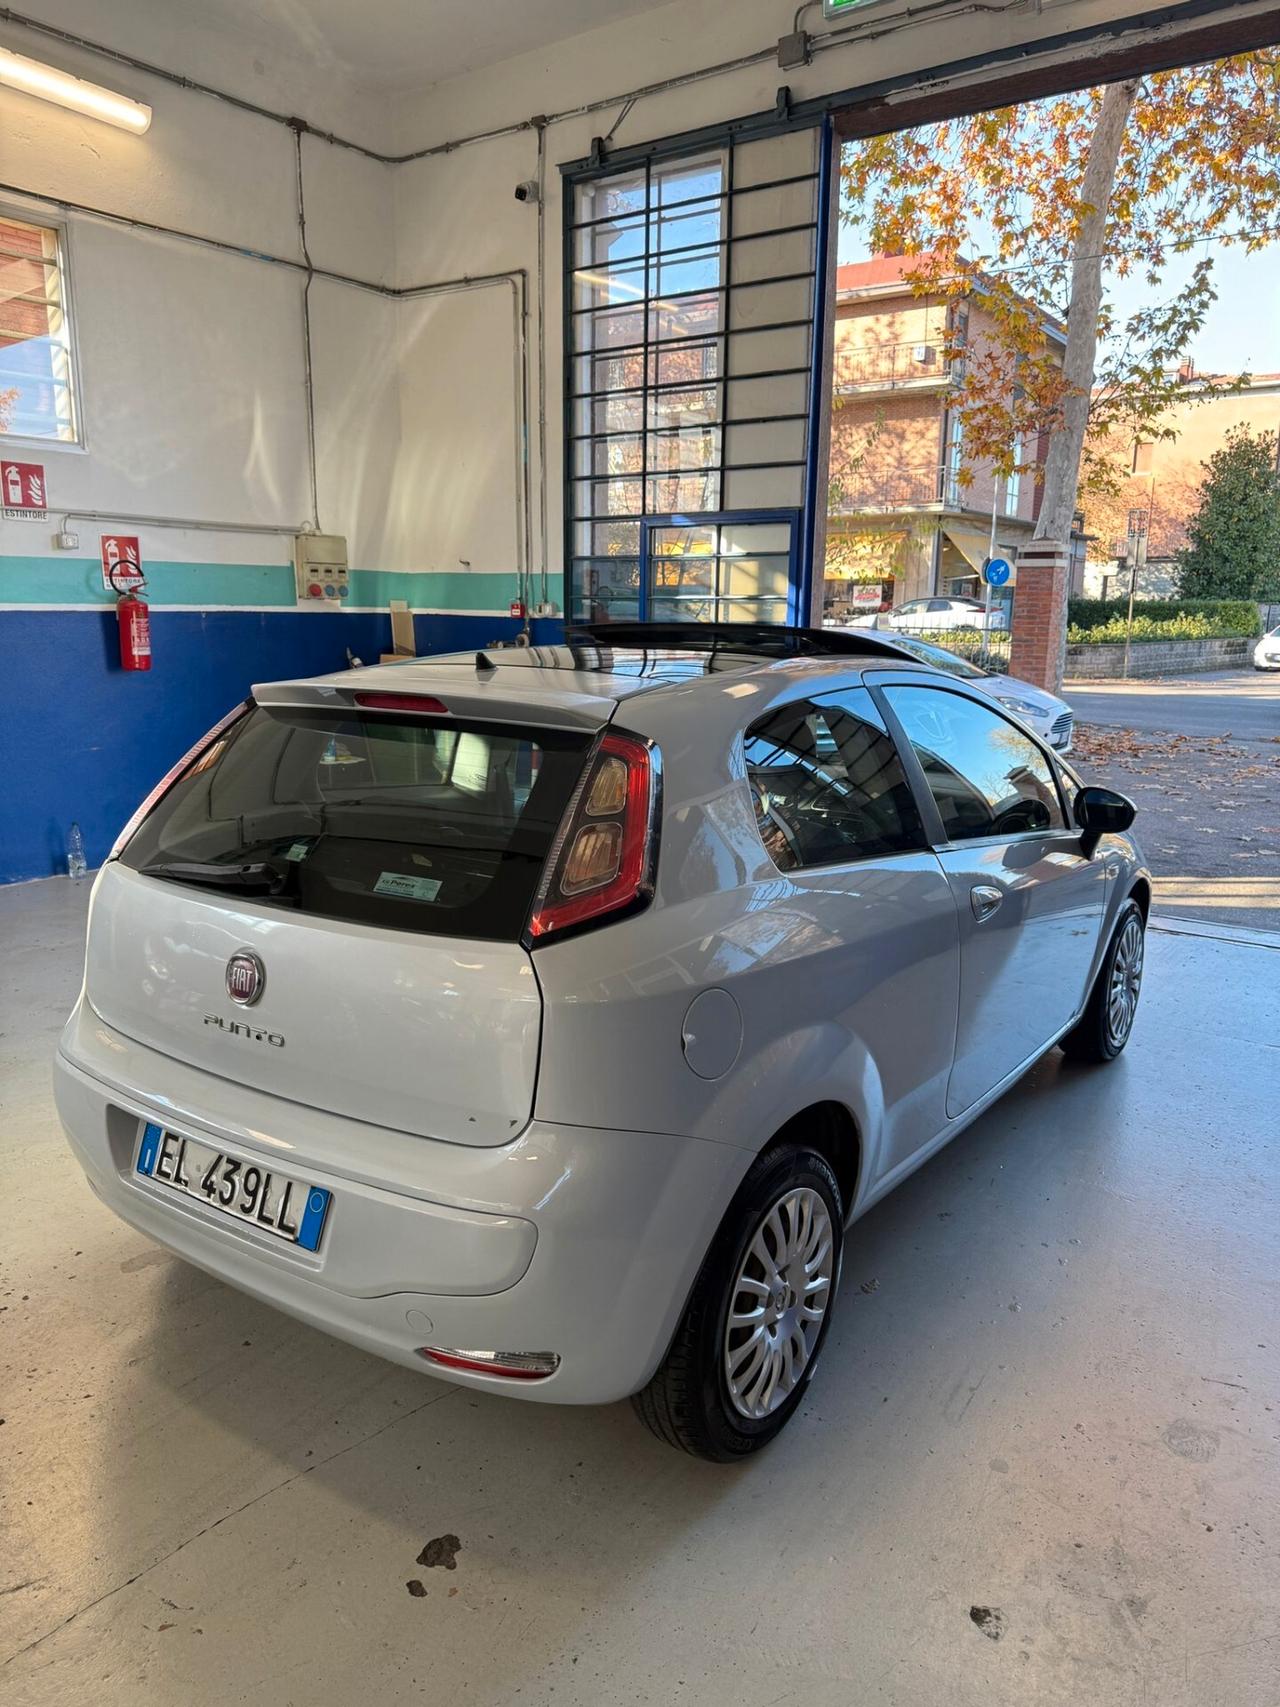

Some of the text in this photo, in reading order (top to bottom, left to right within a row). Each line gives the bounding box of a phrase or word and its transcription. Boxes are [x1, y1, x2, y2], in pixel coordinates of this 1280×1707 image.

[5, 508, 47, 520] ESTINTORE
[232, 967, 253, 993] FIAT
[203, 1012, 286, 1048] PUNTO
[157, 1131, 297, 1235] EL 439LL
